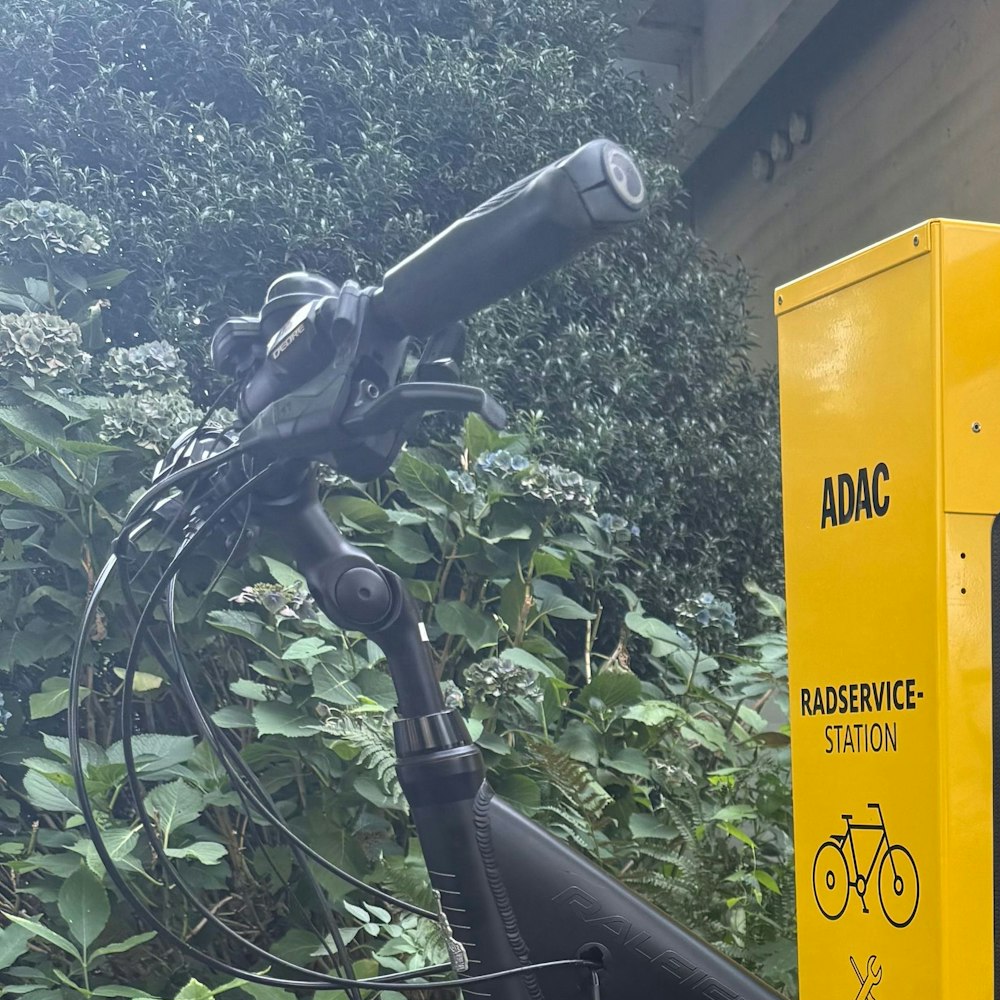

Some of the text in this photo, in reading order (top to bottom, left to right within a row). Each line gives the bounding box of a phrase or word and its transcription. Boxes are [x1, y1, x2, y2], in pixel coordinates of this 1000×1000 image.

[272, 322, 305, 360] DEORE
[820, 462, 890, 529] ADAC
[801, 678, 925, 716] RADSERVICE-
[824, 722, 898, 754] STATION
